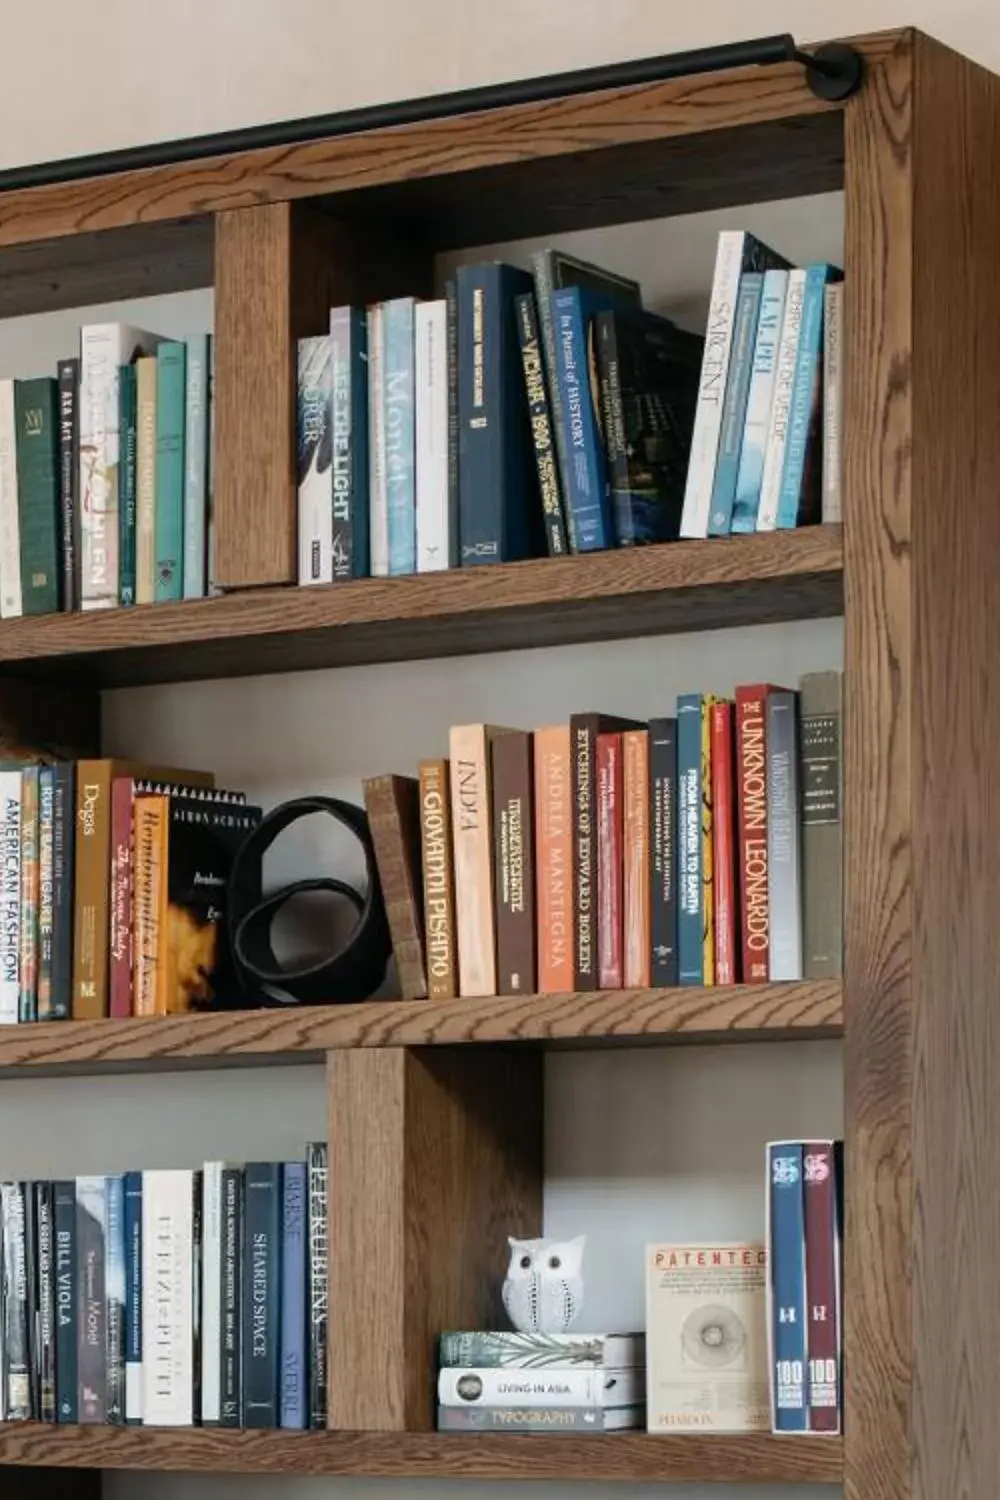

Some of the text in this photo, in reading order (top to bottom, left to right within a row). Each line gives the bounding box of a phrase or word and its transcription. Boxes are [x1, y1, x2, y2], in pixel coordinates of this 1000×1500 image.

[560, 315, 585, 448] In Pursuit of HISTORY
[704, 302, 729, 407] SARGENT
[63, 391, 74, 442] AXA Art
[333, 358, 351, 522] SEE THE LIGHT
[386, 369, 410, 483] Monet
[80, 783, 101, 837] Degas
[458, 760, 479, 832] INDIA
[686, 769, 700, 916] FROM HEAVEN TO EARTH
[743, 718, 768, 951] UNKNOWN LEONARDO
[3, 798, 21, 983] AMERICAN FASHION
[423, 792, 449, 979] GIOVANNI PISANO
[549, 752, 565, 968] ANDREA MANTEGNA
[577, 728, 592, 975] ETCHINGS OF EDWARD BOREIN
[112, 925, 128, 962] Party
[57, 1230, 73, 1326] BILL VIOLA
[86, 1300, 102, 1346] Monet
[252, 1232, 267, 1357] SHARED SPACE
[310, 1214, 328, 1326] RUBENS
[492, 1411, 576, 1425] TYPOGRAPHY
[497, 1383, 571, 1394] LIVING IN ASIA
[776, 1360, 804, 1385] 100
[808, 1359, 836, 1384] 100
